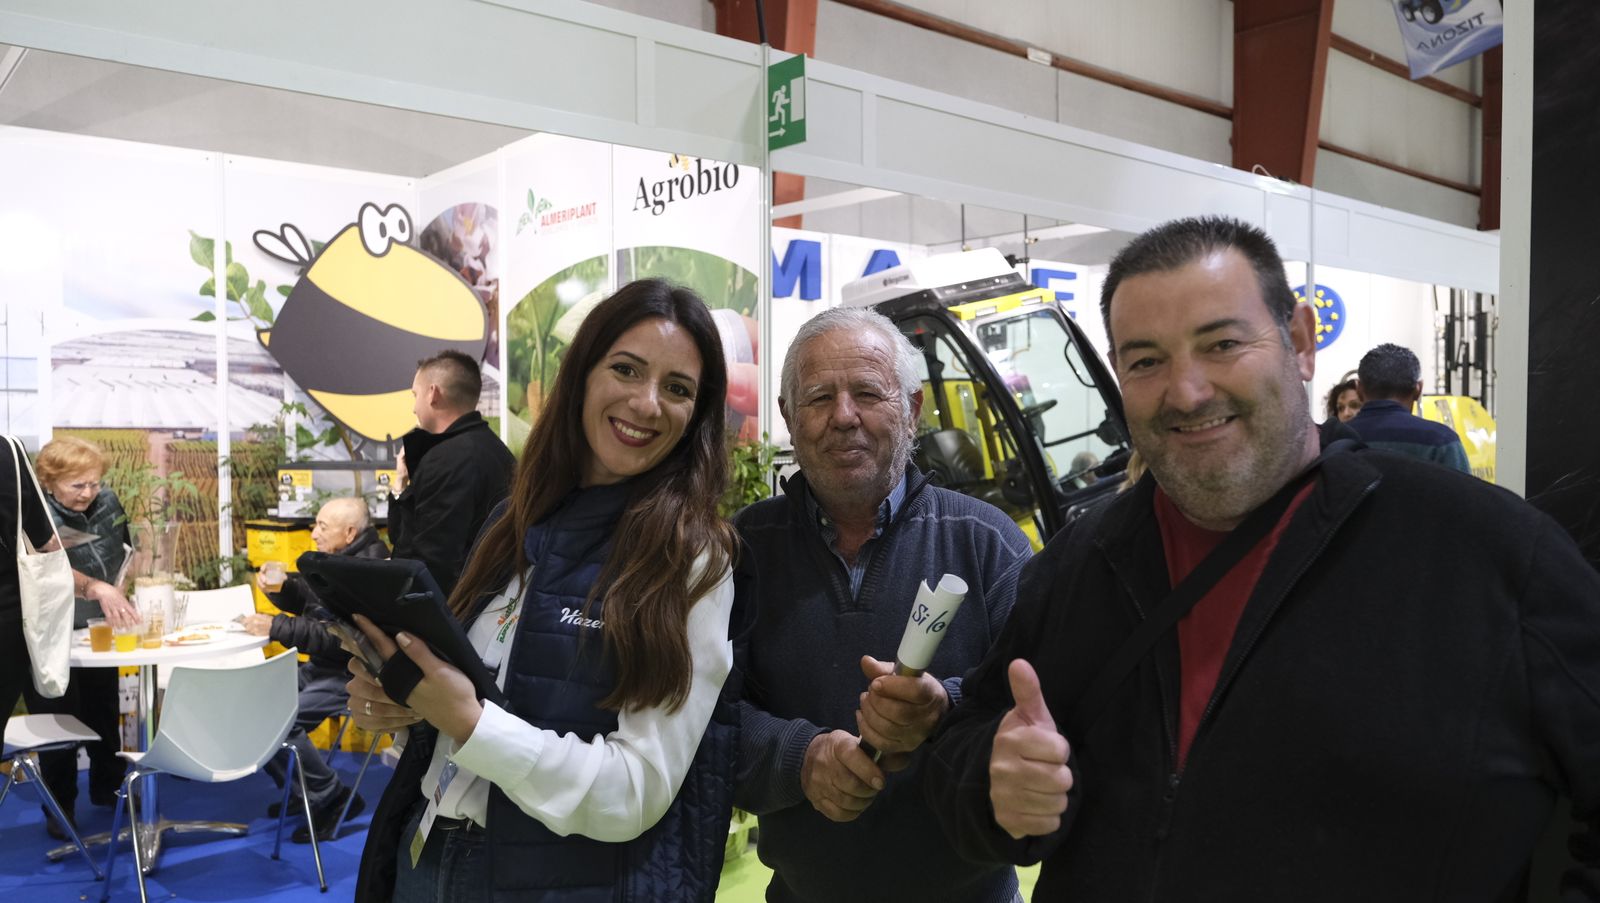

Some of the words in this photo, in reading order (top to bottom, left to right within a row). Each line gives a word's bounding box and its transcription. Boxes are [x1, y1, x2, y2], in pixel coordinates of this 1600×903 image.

[632, 157, 740, 216] Agrobio
[541, 201, 597, 227] ALMERIPLANT
[911, 603, 931, 627] Si
